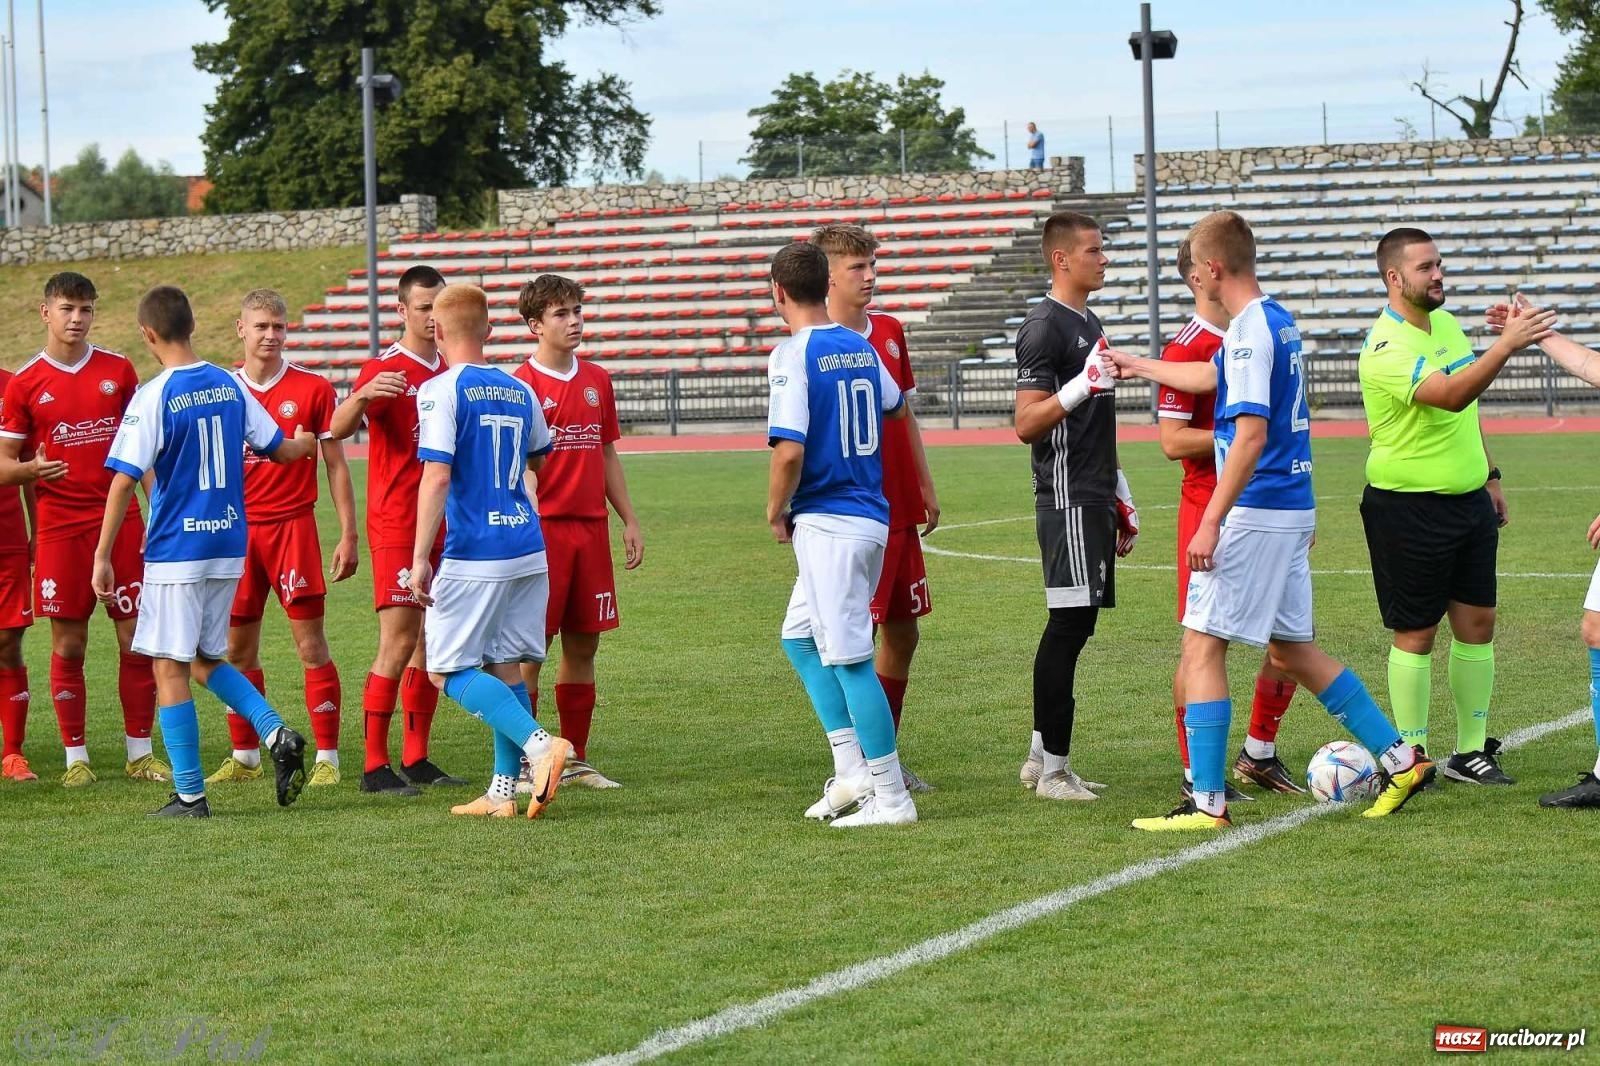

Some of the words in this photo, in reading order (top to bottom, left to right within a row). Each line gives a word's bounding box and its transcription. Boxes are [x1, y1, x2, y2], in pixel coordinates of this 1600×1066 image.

[816, 353, 841, 373] UNIA
[167, 392, 193, 413] UNIA
[464, 386, 486, 402] UNIA
[485, 385, 527, 406] RACIBÓRZ
[837, 378, 879, 458] 10
[197, 415, 226, 491] 11
[479, 413, 524, 490] 77
[183, 517, 232, 534] Empol
[488, 510, 529, 529] Empol
[909, 576, 929, 614] 57
